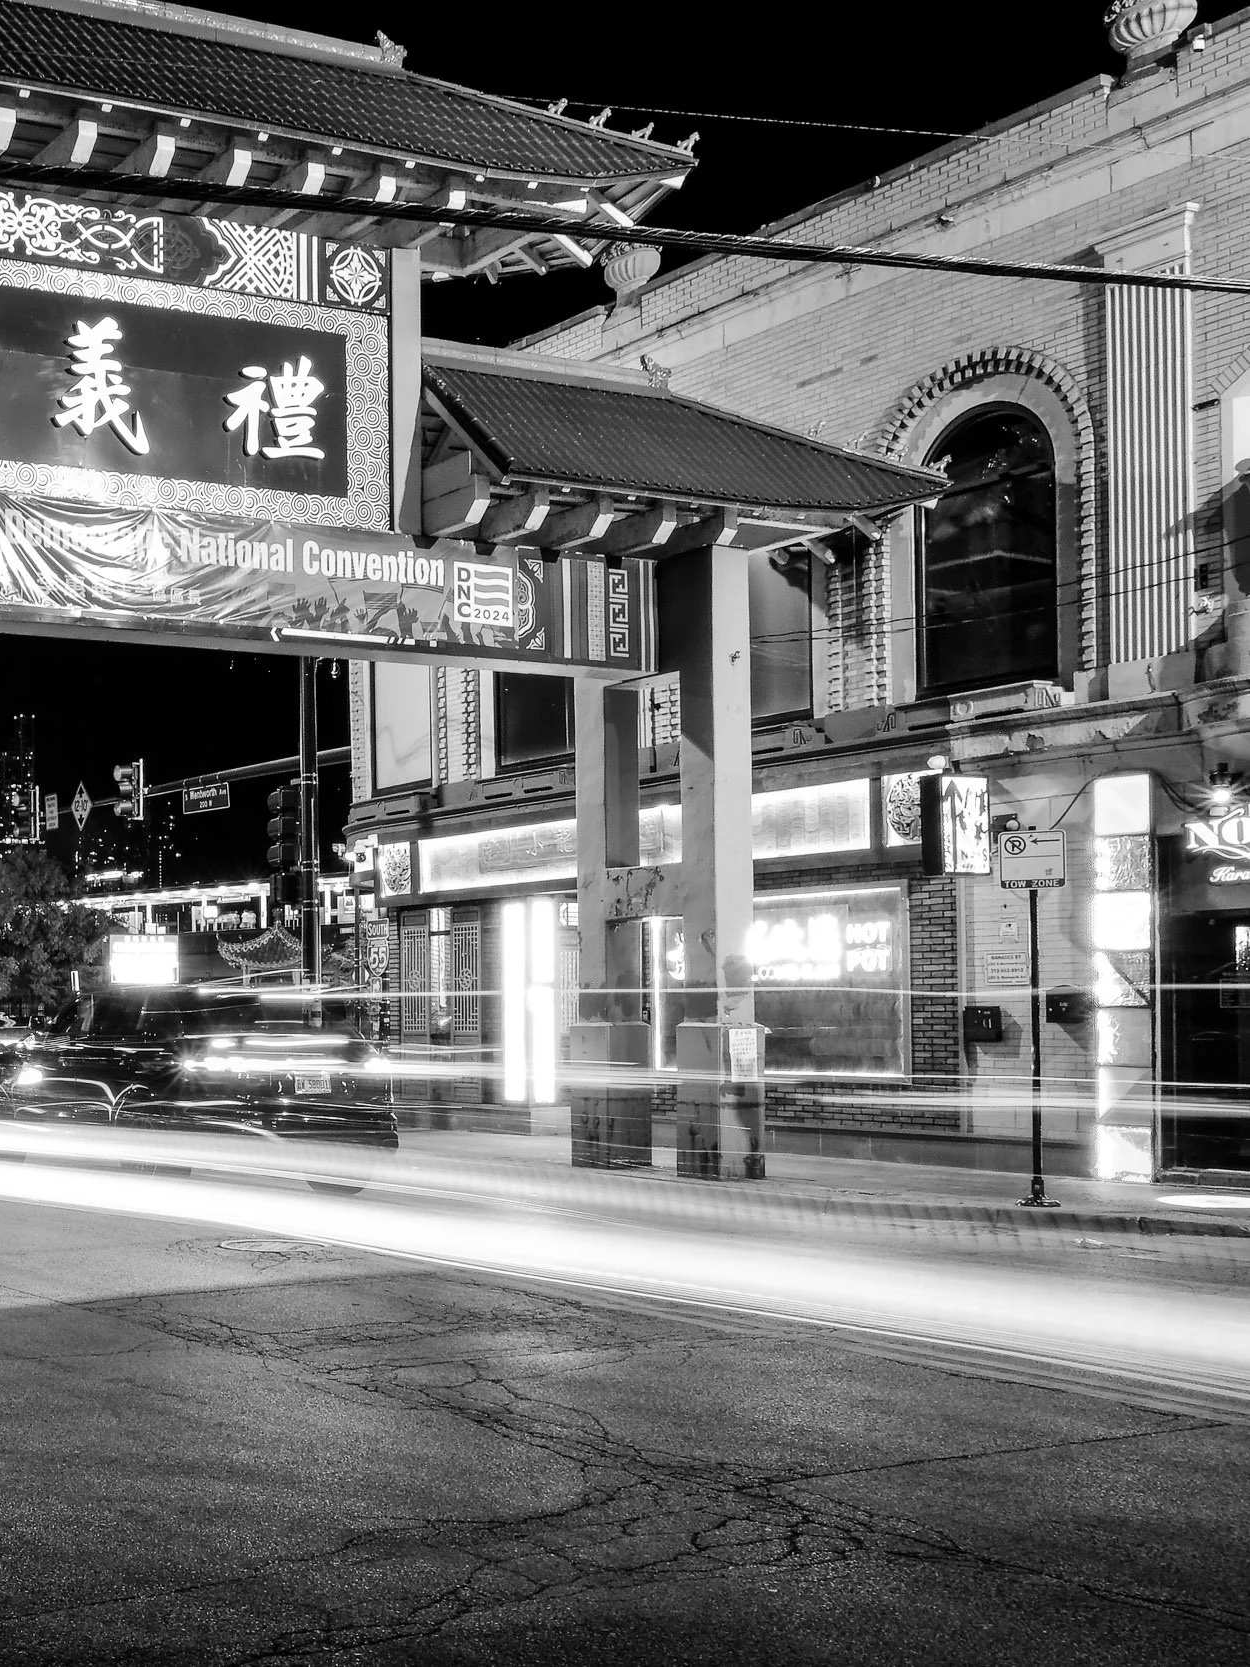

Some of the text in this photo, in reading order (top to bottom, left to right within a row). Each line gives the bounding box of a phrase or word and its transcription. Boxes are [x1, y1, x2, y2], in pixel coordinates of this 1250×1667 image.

[181, 526, 294, 574] National
[302, 538, 445, 588] Convention
[474, 608, 509, 622] 2024
[1004, 879, 1060, 889] TOW ZONE
[368, 923, 388, 936] SOUTH
[845, 921, 891, 944] HOT
[370, 947, 387, 969] 55
[846, 948, 891, 972] POT
